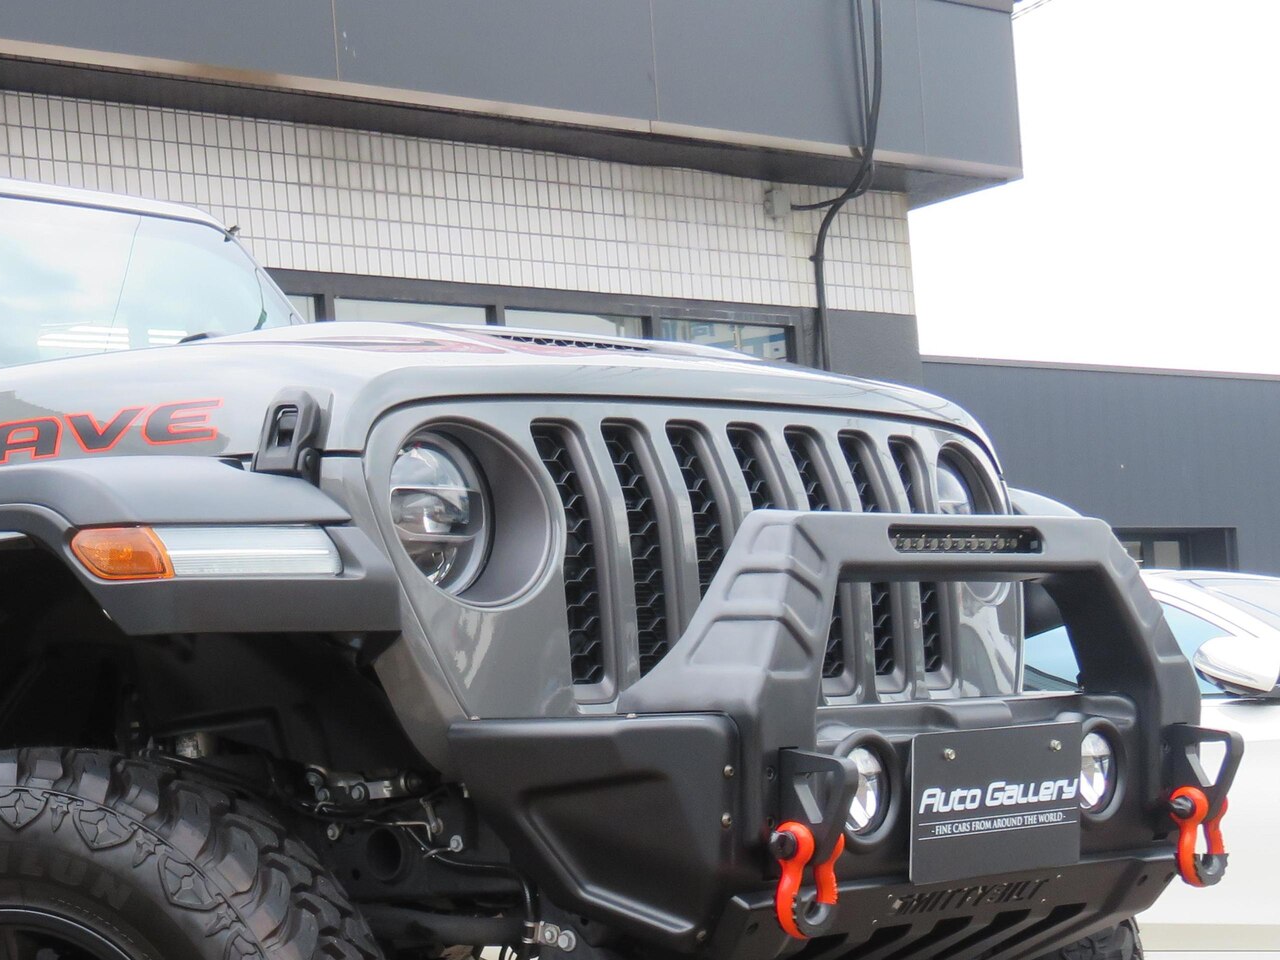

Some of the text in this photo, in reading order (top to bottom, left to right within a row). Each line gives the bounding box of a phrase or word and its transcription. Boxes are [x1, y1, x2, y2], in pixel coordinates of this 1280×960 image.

[919, 777, 1079, 814] Auto Gallery
[953, 821, 971, 833] CARS
[972, 820, 992, 832] FROM
[992, 816, 1023, 830] AROUND
[1023, 814, 1038, 825] THE
